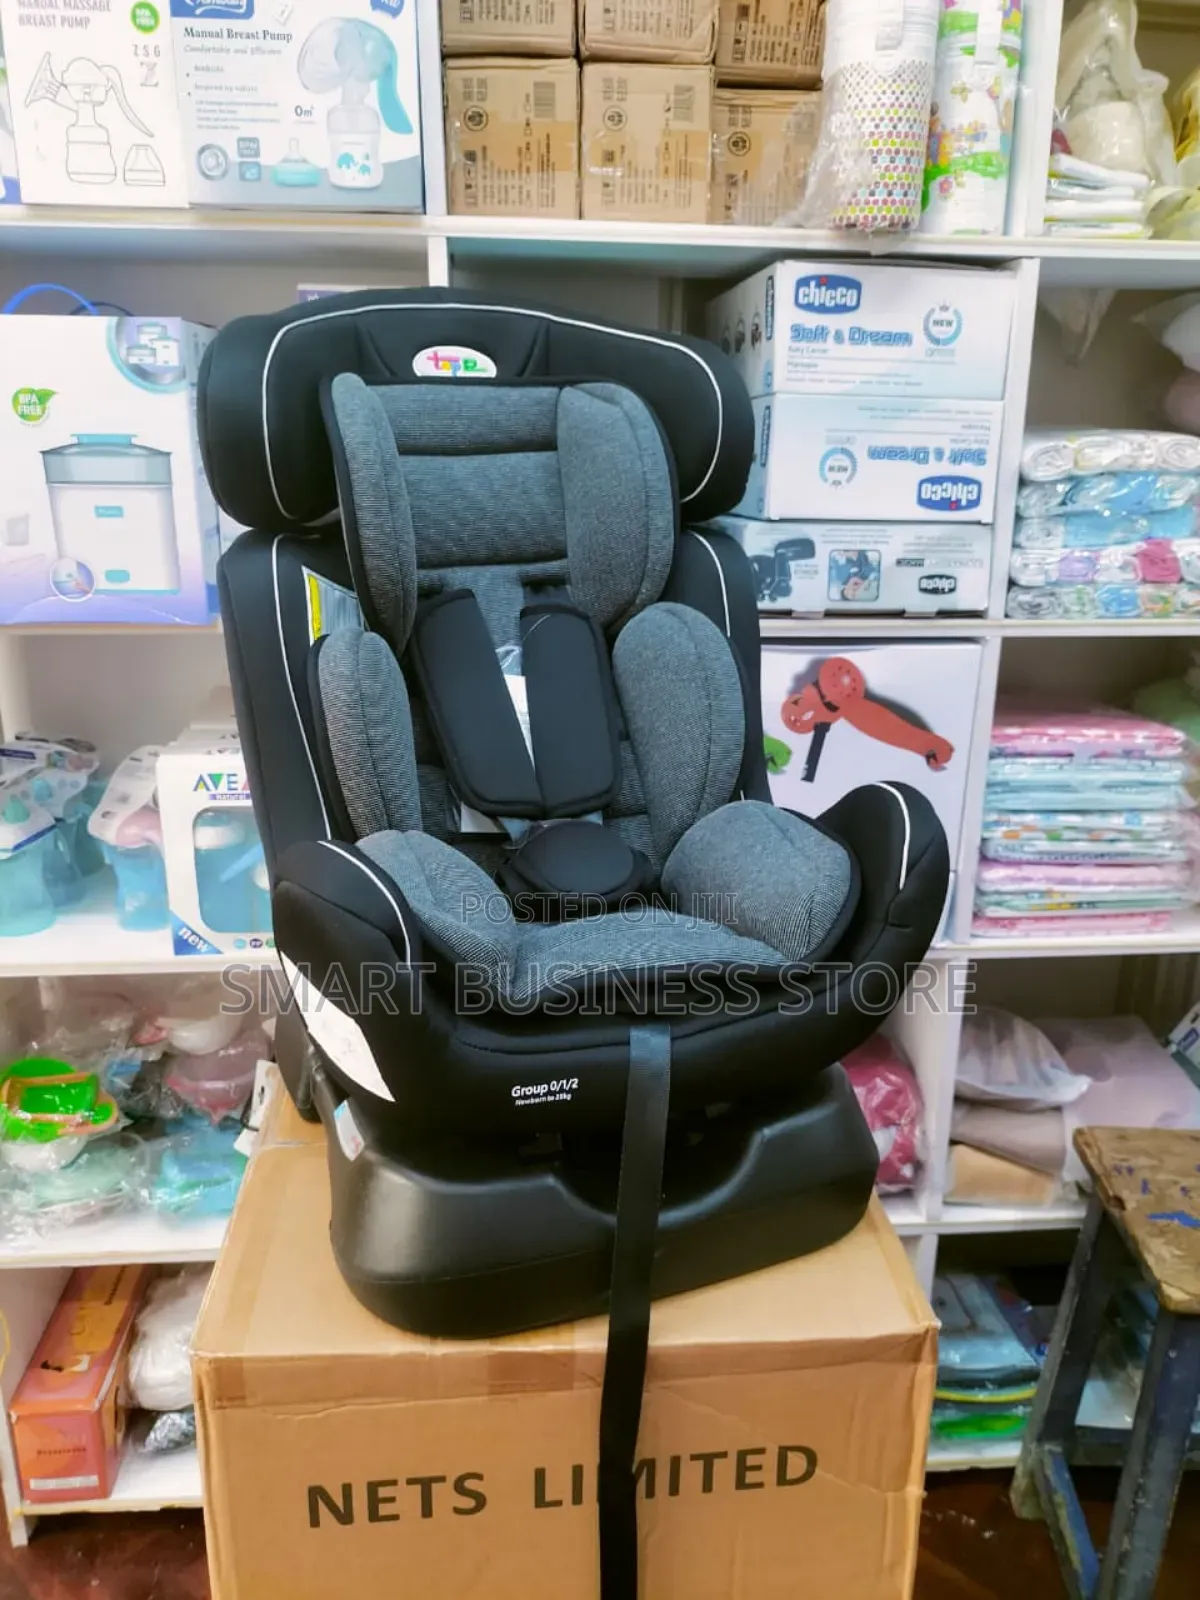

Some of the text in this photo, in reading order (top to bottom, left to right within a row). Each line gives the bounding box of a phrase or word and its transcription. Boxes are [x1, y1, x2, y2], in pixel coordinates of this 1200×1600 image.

[63, 0, 111, 12] MASSAGE
[18, 14, 91, 30] BREAST PUMP
[183, 27, 293, 43] Manual Breast Pump
[798, 275, 858, 308] chicco
[790, 322, 830, 343] Soft
[848, 326, 914, 347] Dream
[19, 394, 40, 405] BPA
[19, 404, 41, 416] FREE
[920, 481, 979, 511] chicco
[511, 1078, 579, 1097] Group 0/1/2
[515, 1097, 547, 1106] Newborn
[307, 1471, 488, 1529] NETS
